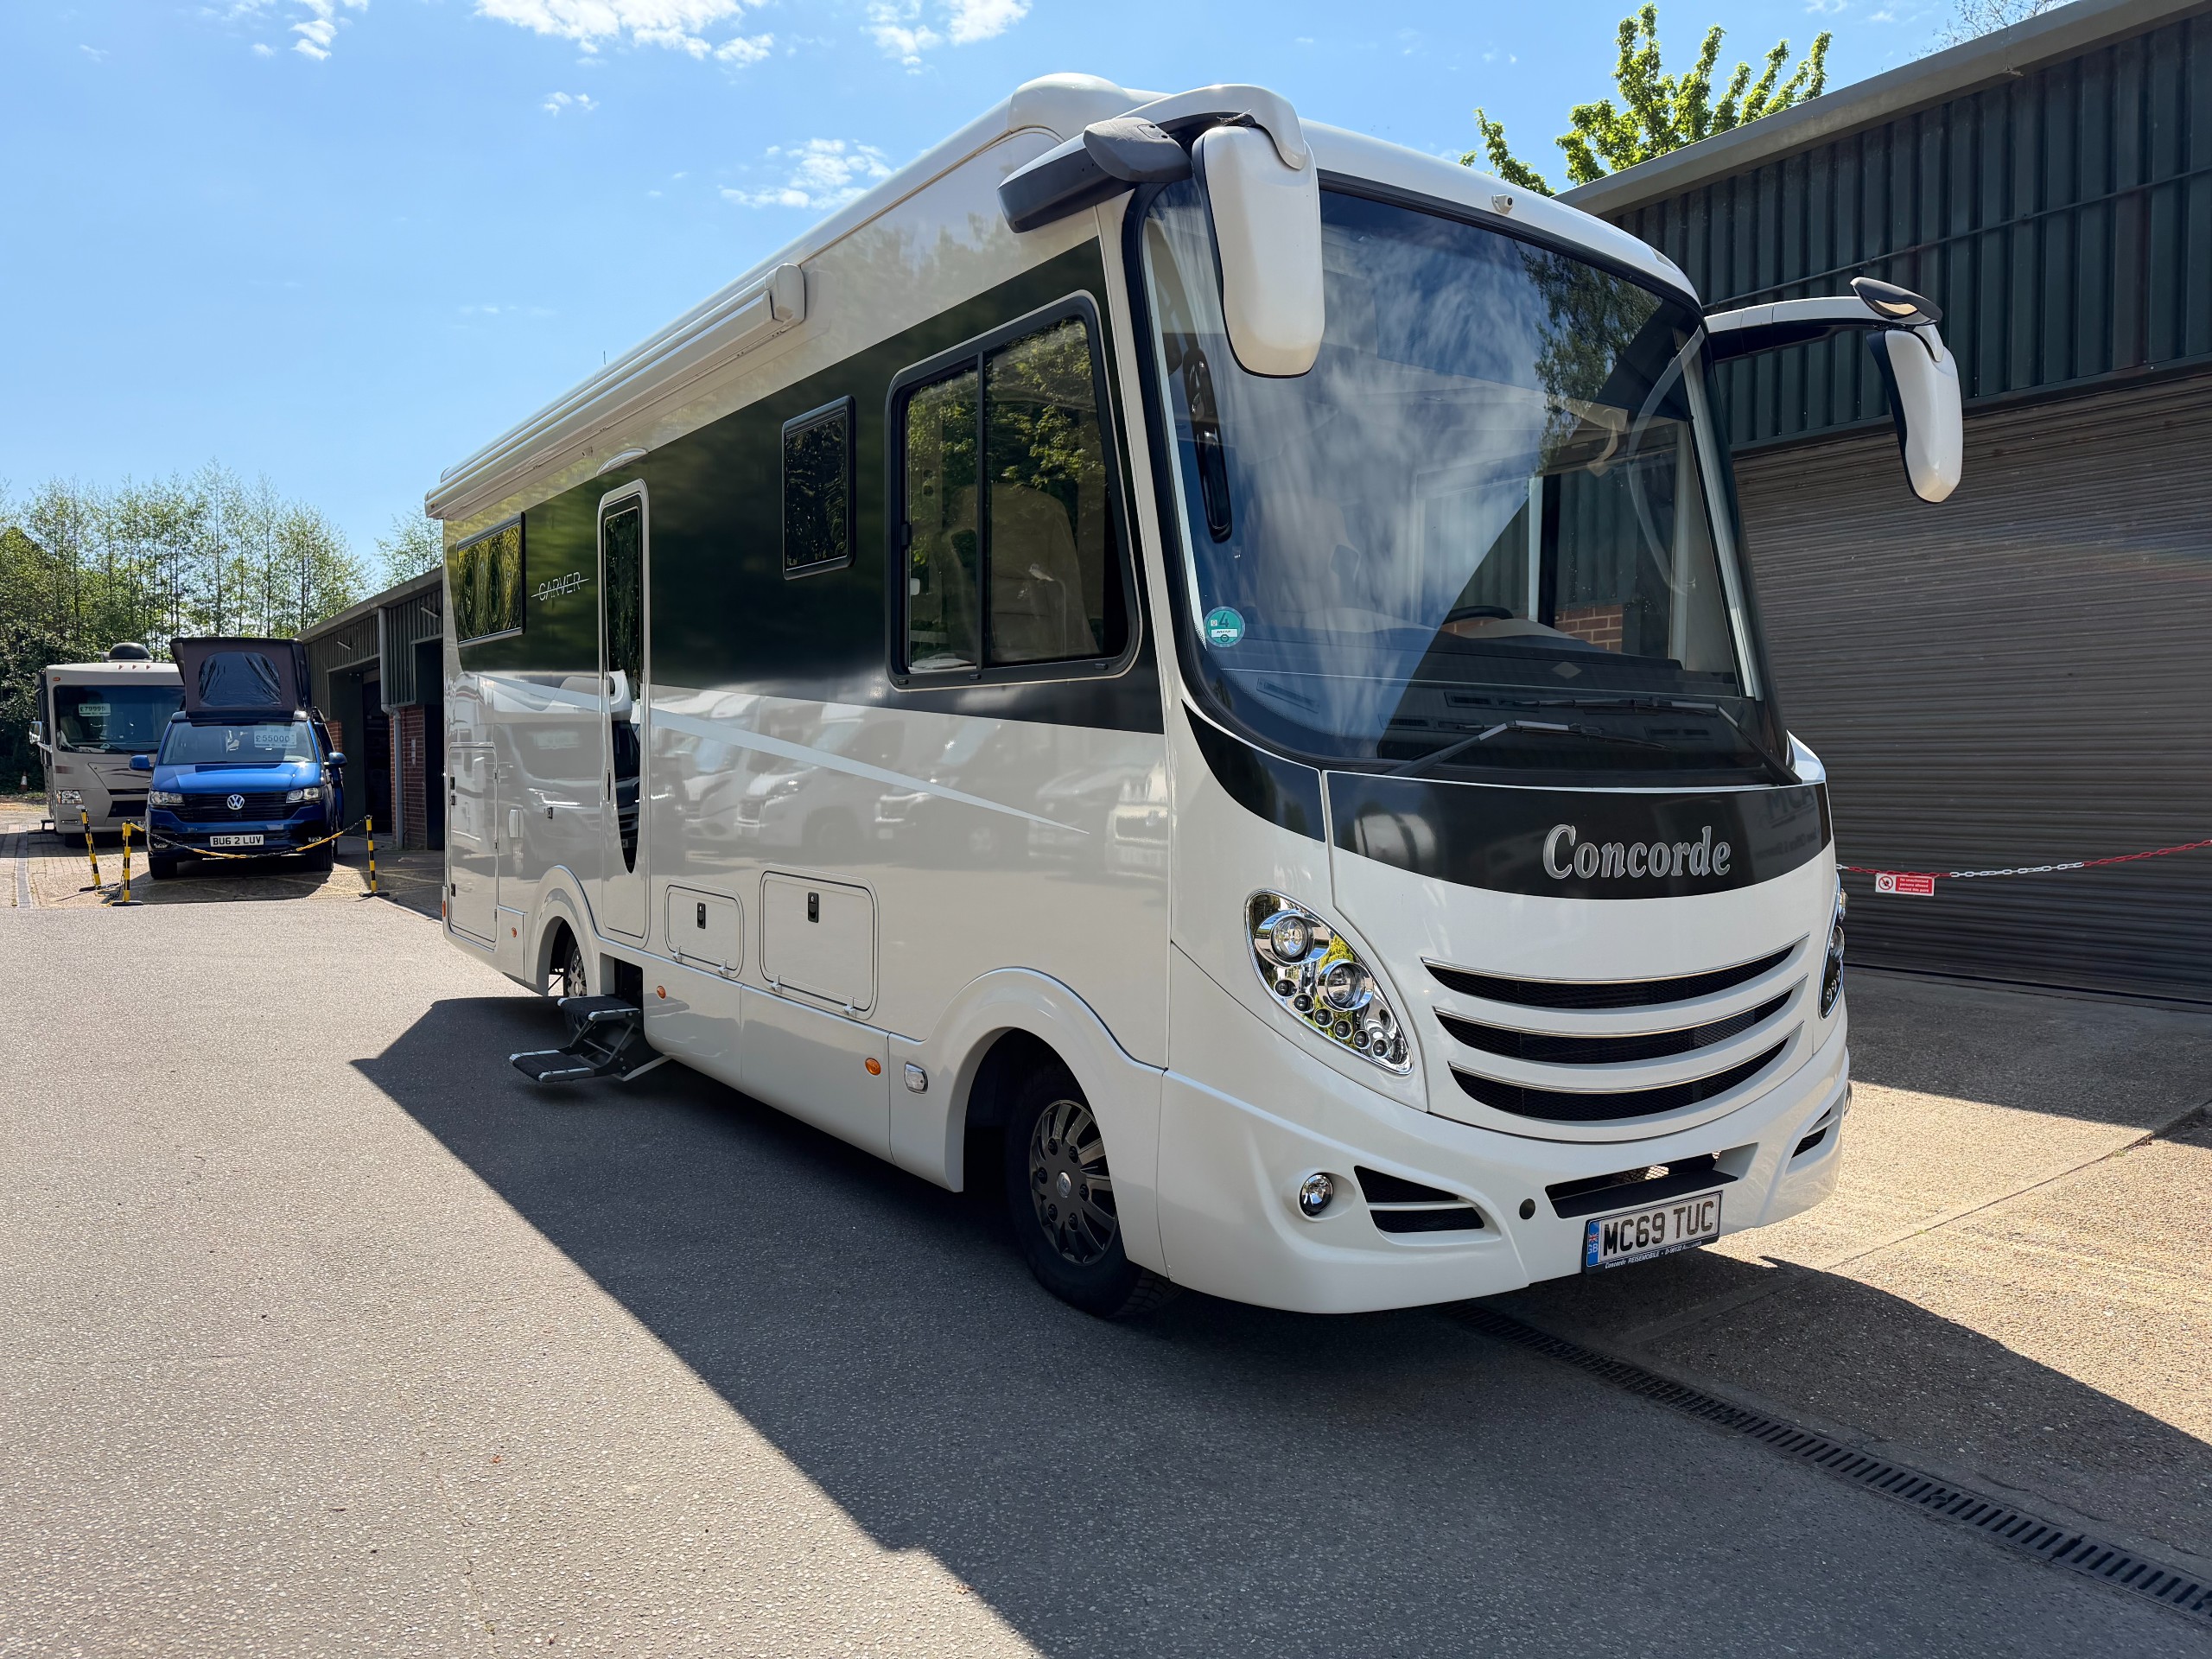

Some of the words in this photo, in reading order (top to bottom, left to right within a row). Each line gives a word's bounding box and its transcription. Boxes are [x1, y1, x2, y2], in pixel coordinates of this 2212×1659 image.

[538, 571, 581, 601] CARVER
[1218, 612, 1230, 627] 4
[213, 836, 231, 845] BU6
[243, 836, 261, 844] LUV
[1542, 823, 1731, 880] Concorde
[1603, 1211, 1666, 1256] MC69
[1673, 1200, 1714, 1239] TUC
[1587, 1243, 1599, 1255] GB
